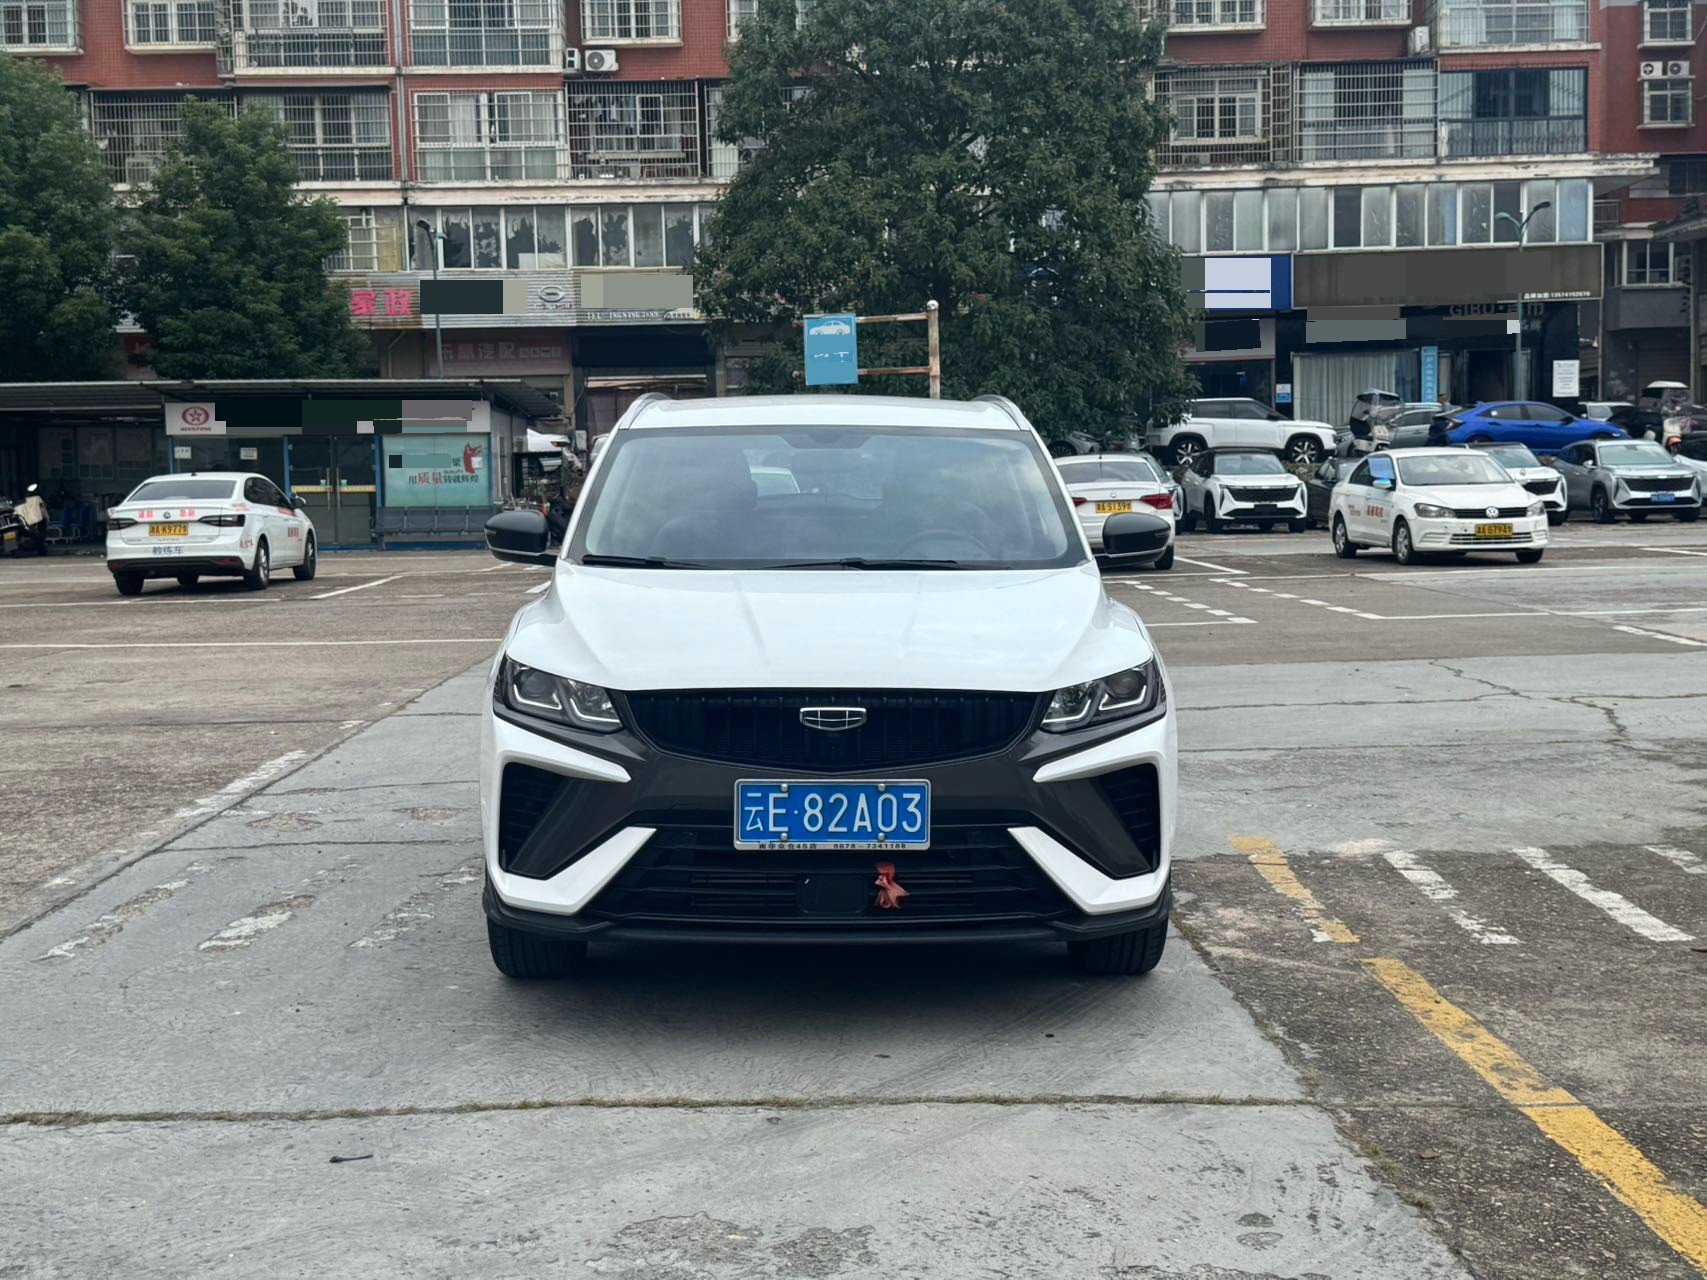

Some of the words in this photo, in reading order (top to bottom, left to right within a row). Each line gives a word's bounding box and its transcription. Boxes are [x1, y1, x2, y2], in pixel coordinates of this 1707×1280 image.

[351, 289, 412, 316] 家政
[152, 546, 184, 555] 教练车
[744, 793, 922, 832] 云E·82A03
